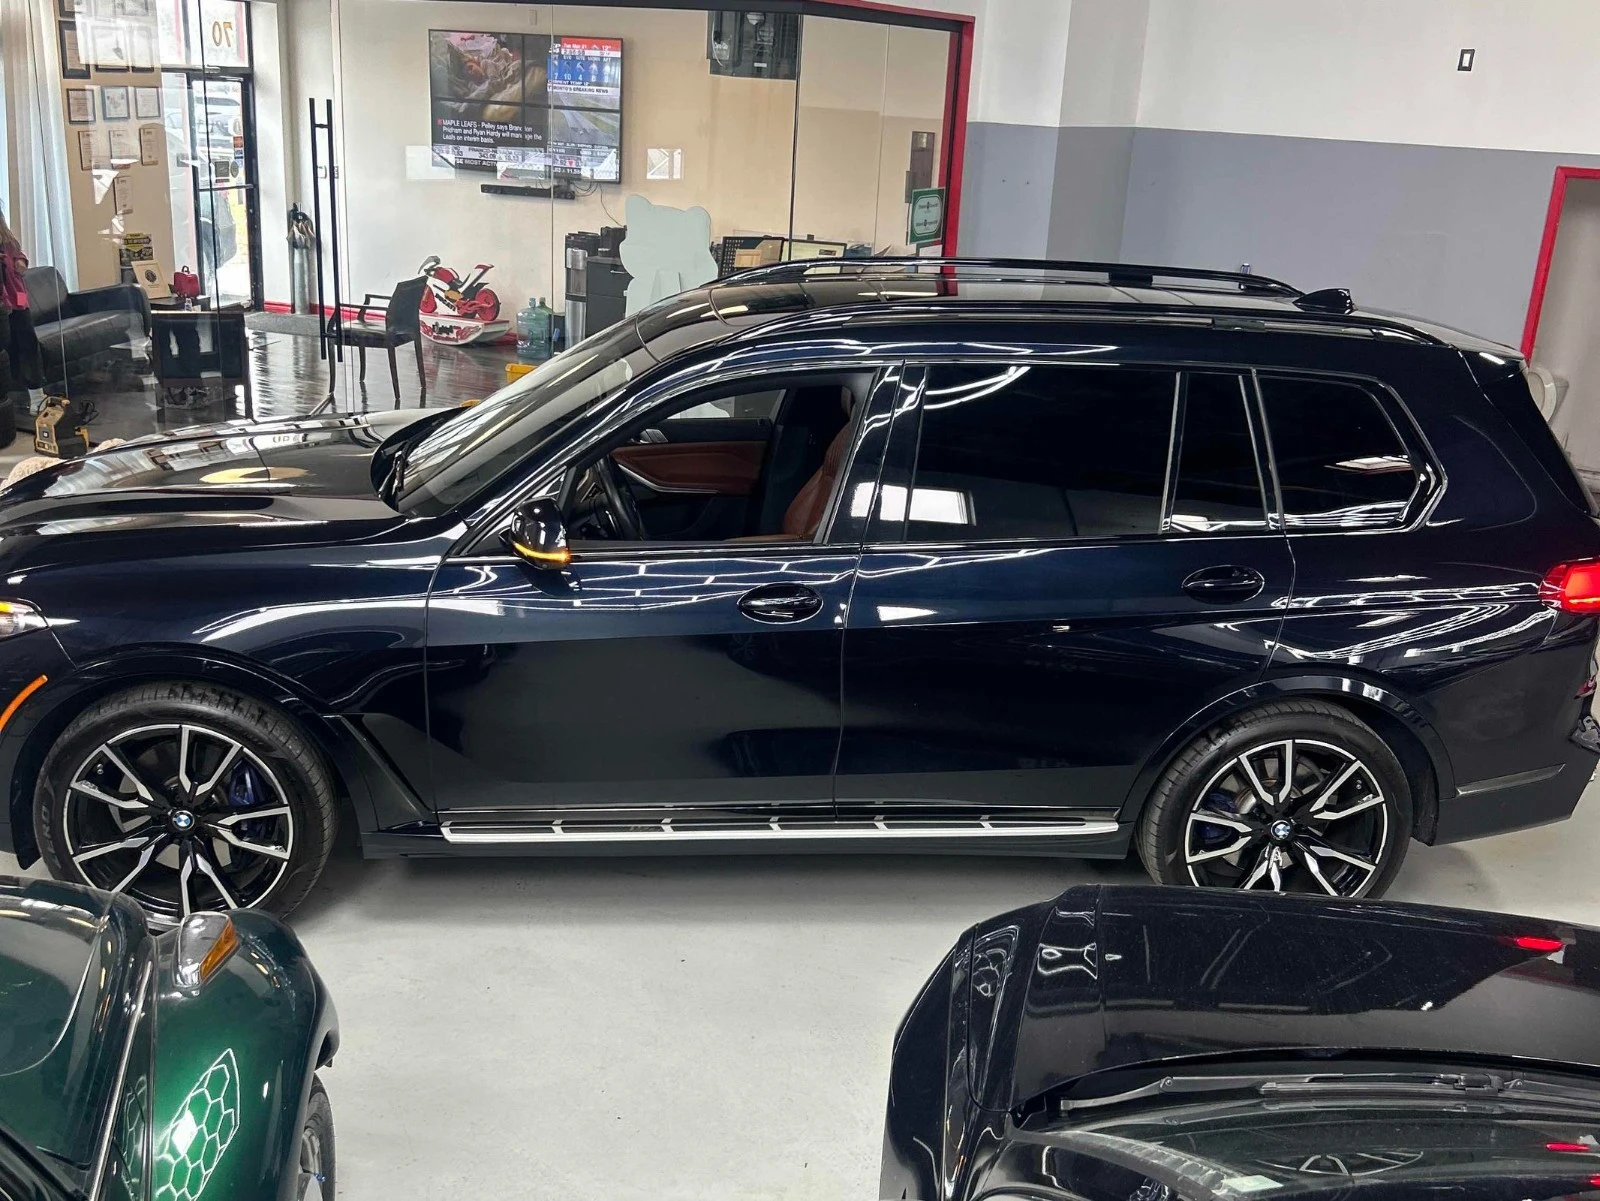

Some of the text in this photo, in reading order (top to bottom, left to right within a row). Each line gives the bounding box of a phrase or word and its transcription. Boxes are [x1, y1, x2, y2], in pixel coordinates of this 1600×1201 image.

[461, 120, 477, 128] LEAFS
[481, 122, 496, 130] Pelley
[486, 129, 501, 137] Hardy
